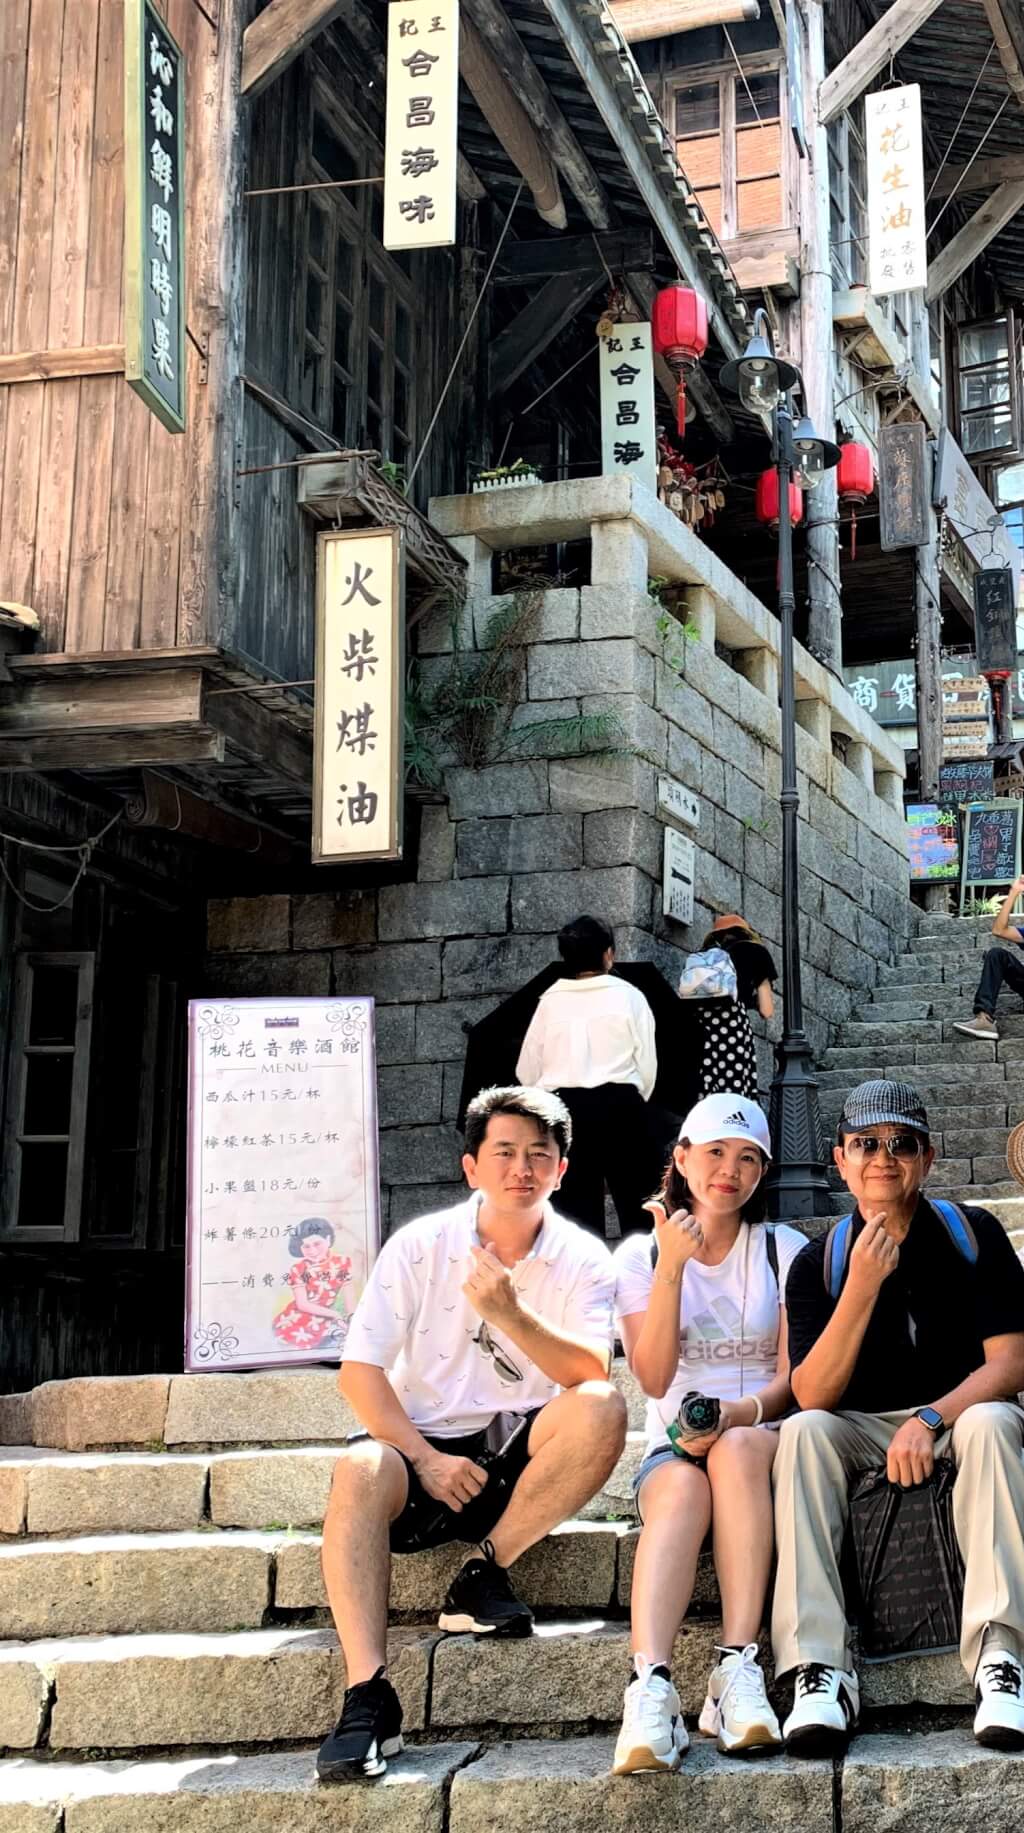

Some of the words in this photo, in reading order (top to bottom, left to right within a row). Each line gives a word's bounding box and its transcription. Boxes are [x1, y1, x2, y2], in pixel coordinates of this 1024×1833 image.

[399, 48, 440, 224] 合昌海味
[879, 122, 912, 233] 花生油
[610, 362, 645, 465] 合昌海
[336, 561, 382, 827] 火柴煤油
[261, 1062, 309, 1073] MENU
[722, 1119, 750, 1129] adidas
[680, 1339, 778, 1360] didas
